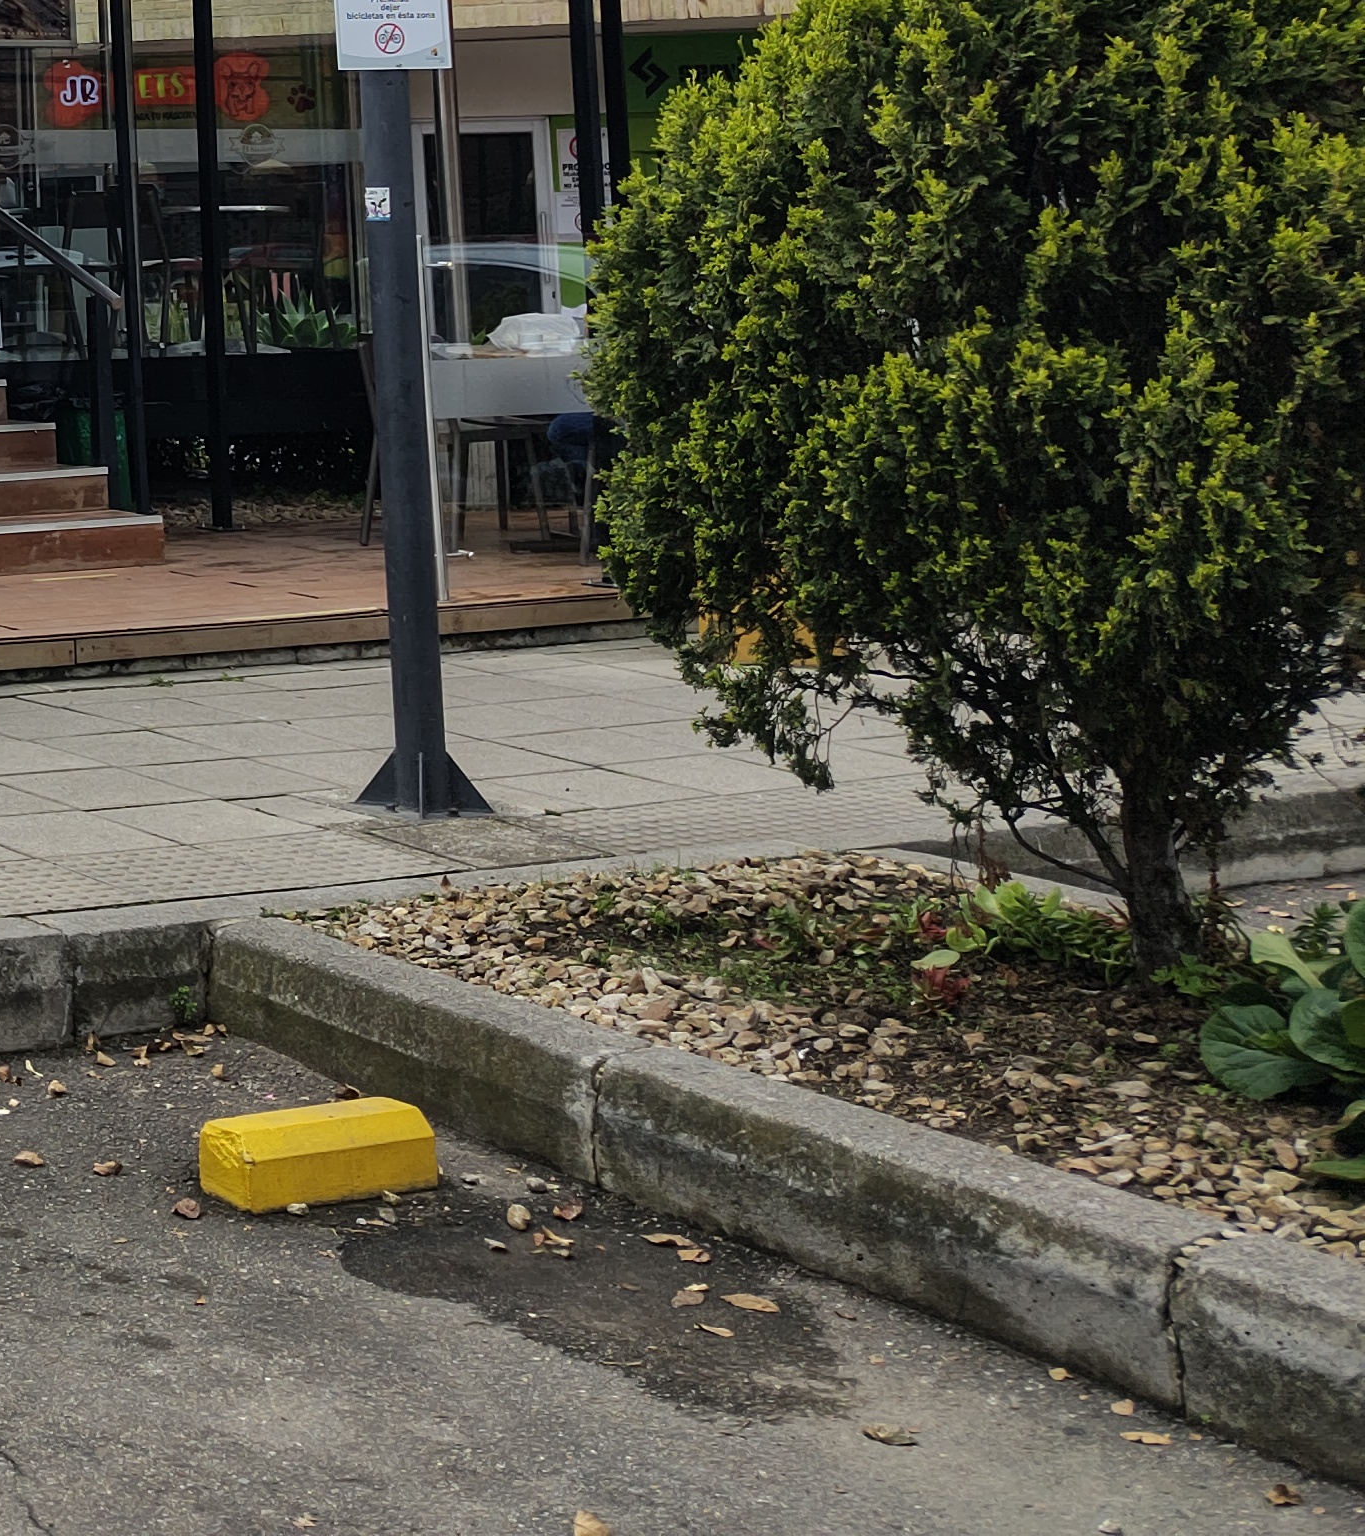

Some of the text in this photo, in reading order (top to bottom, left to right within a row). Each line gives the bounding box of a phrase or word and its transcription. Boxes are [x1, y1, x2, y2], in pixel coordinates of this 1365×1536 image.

[380, 4, 400, 13] dejar
[346, 12, 384, 20] bicicletas
[60, 72, 186, 106] JR ETS
